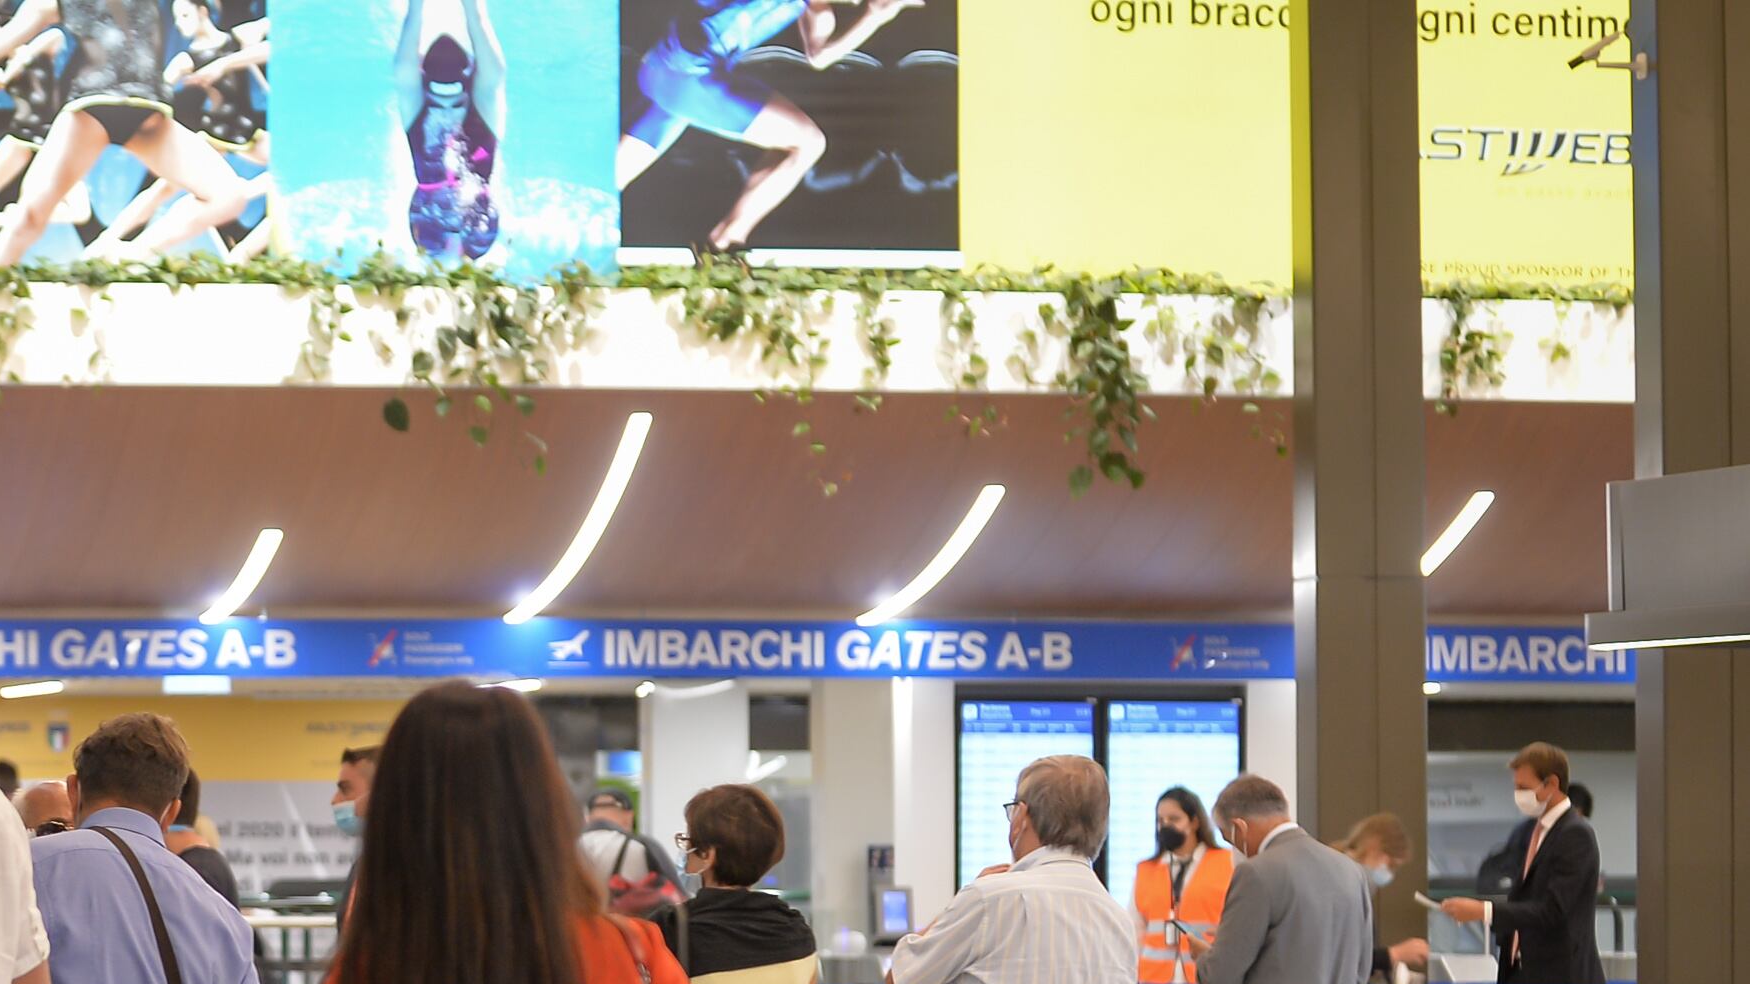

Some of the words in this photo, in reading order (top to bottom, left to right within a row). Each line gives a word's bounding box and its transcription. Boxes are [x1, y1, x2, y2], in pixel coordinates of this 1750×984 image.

[1091, 0, 1173, 32] ogni
[1418, 3, 1475, 42] gni
[1507, 264, 1583, 276] SPONSOR
[50, 628, 209, 669] GATES
[214, 629, 296, 668] A-B
[603, 629, 824, 669] IMBARCHI
[836, 628, 986, 670] GATES
[996, 629, 1072, 669] A-B
